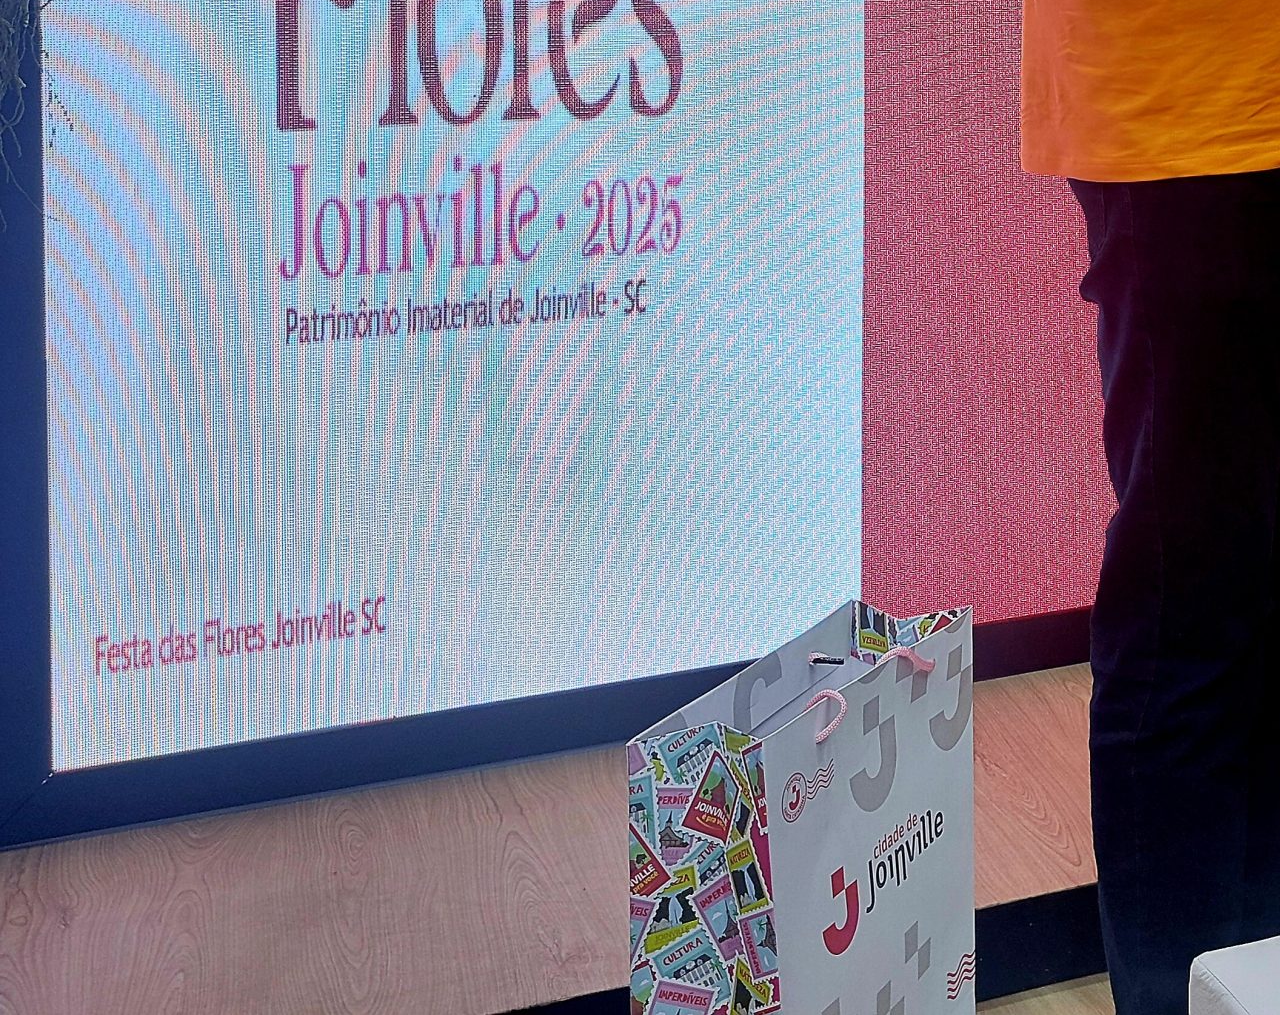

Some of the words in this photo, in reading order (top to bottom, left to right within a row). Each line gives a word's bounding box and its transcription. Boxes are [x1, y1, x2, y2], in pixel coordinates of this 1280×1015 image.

[280, 156, 542, 282] Joinville
[581, 174, 685, 258] 2025
[286, 299, 400, 345] Patrimônio
[406, 289, 494, 334] Imaterial
[500, 287, 524, 326] de
[530, 282, 607, 323] Joinville
[623, 279, 647, 314] SC
[95, 635, 152, 676] Festa
[158, 624, 198, 665] das
[202, 617, 266, 658] Flores
[271, 601, 357, 649] Joinville
[361, 595, 386, 636] SC
[866, 809, 944, 914] Joinville
[873, 824, 905, 860] cidade
[906, 812, 918, 832] de
[663, 936, 703, 966] CULTURA
[659, 988, 709, 1006] IMPERDÍVEIS
